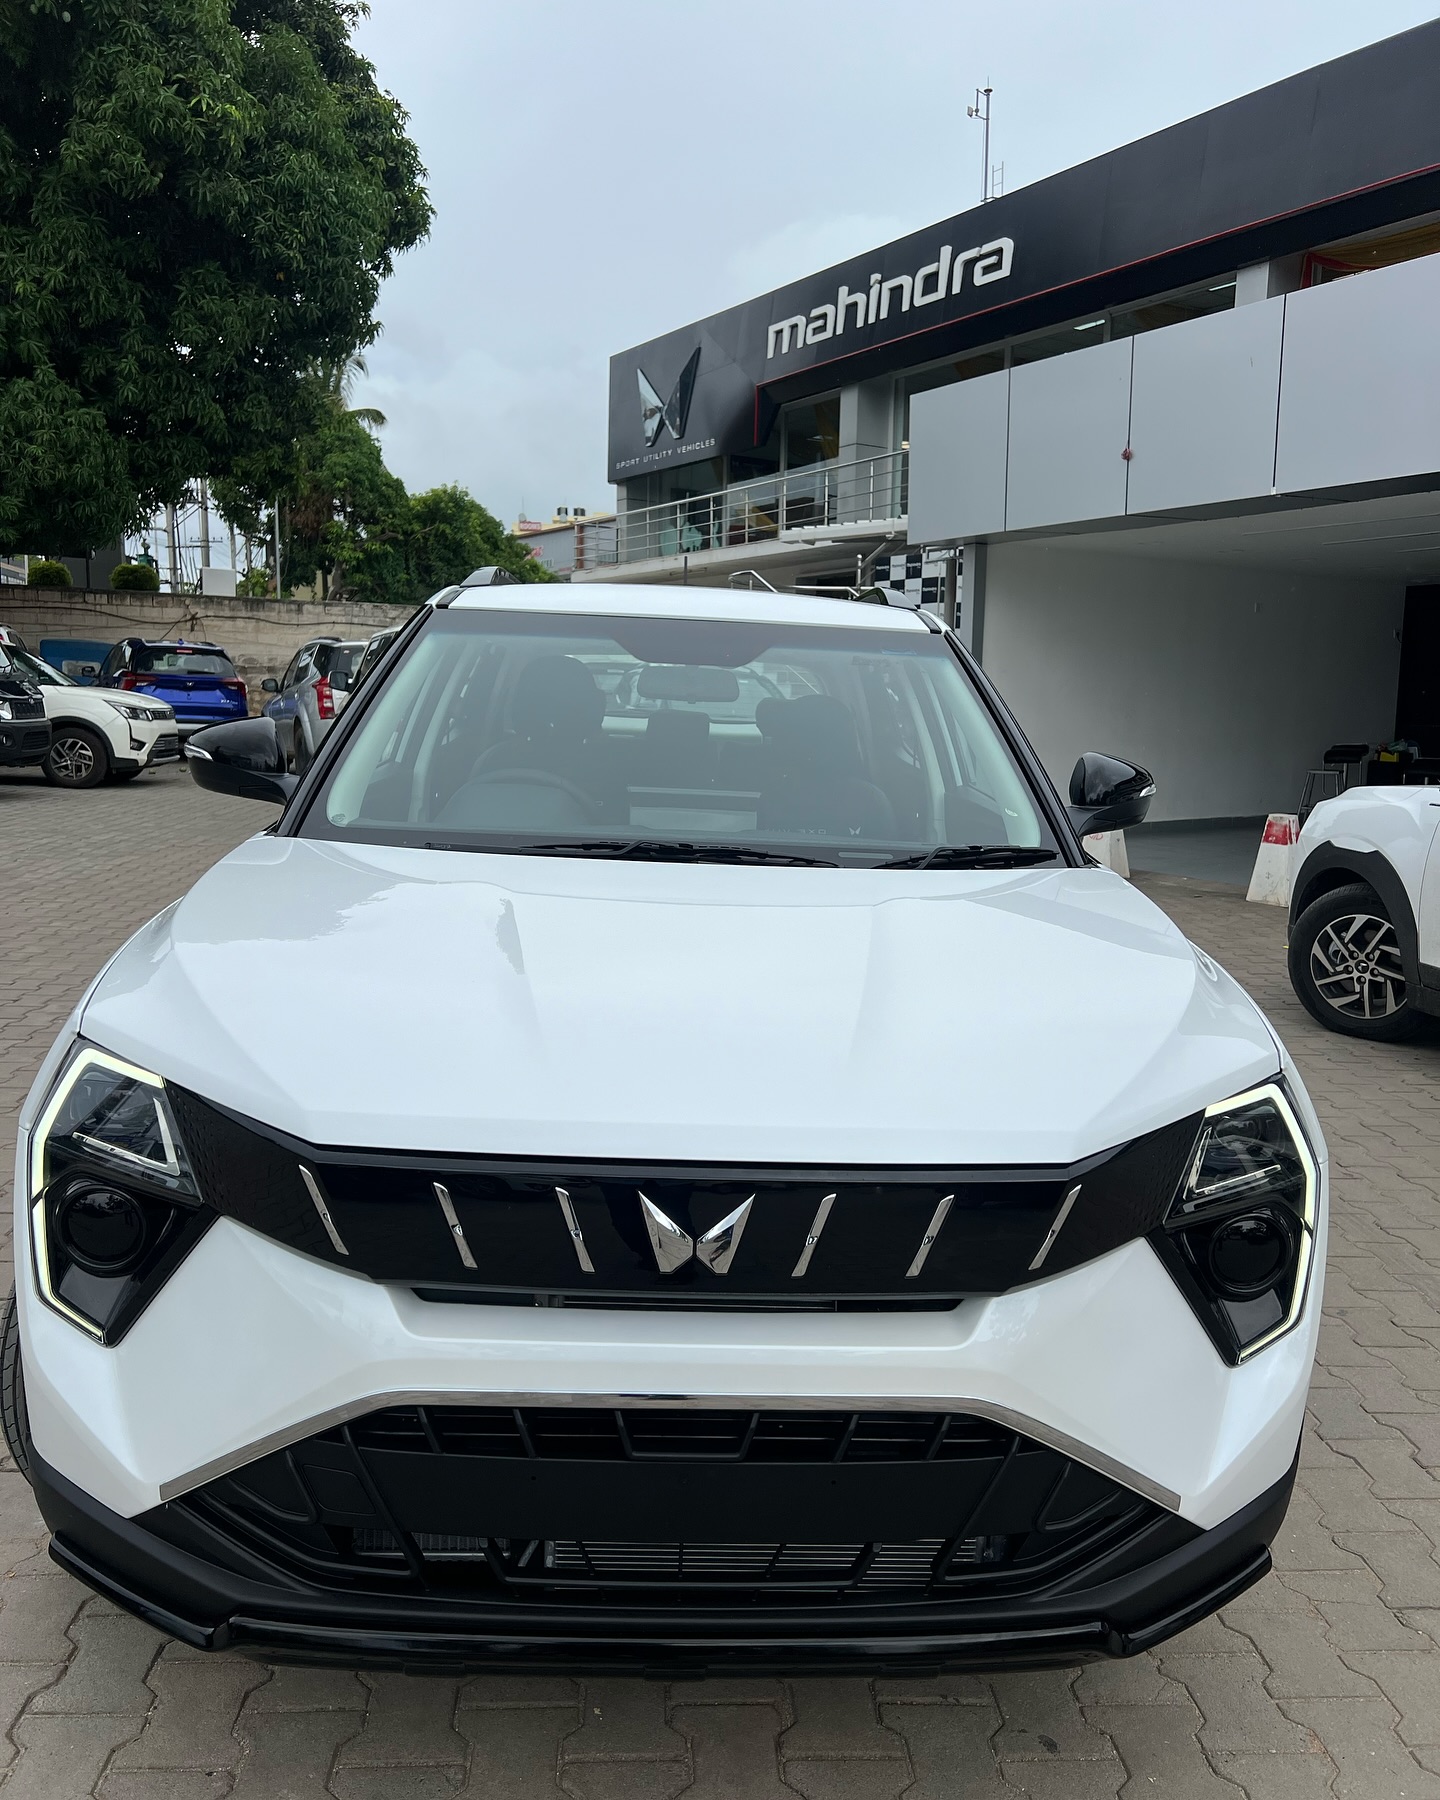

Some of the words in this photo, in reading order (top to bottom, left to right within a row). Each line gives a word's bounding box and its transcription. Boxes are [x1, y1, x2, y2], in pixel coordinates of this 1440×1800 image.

[766, 236, 1015, 360] mahindra
[616, 458, 640, 470] SPORT
[643, 449, 673, 463] UTILITY
[677, 438, 715, 453] VEHICLES
